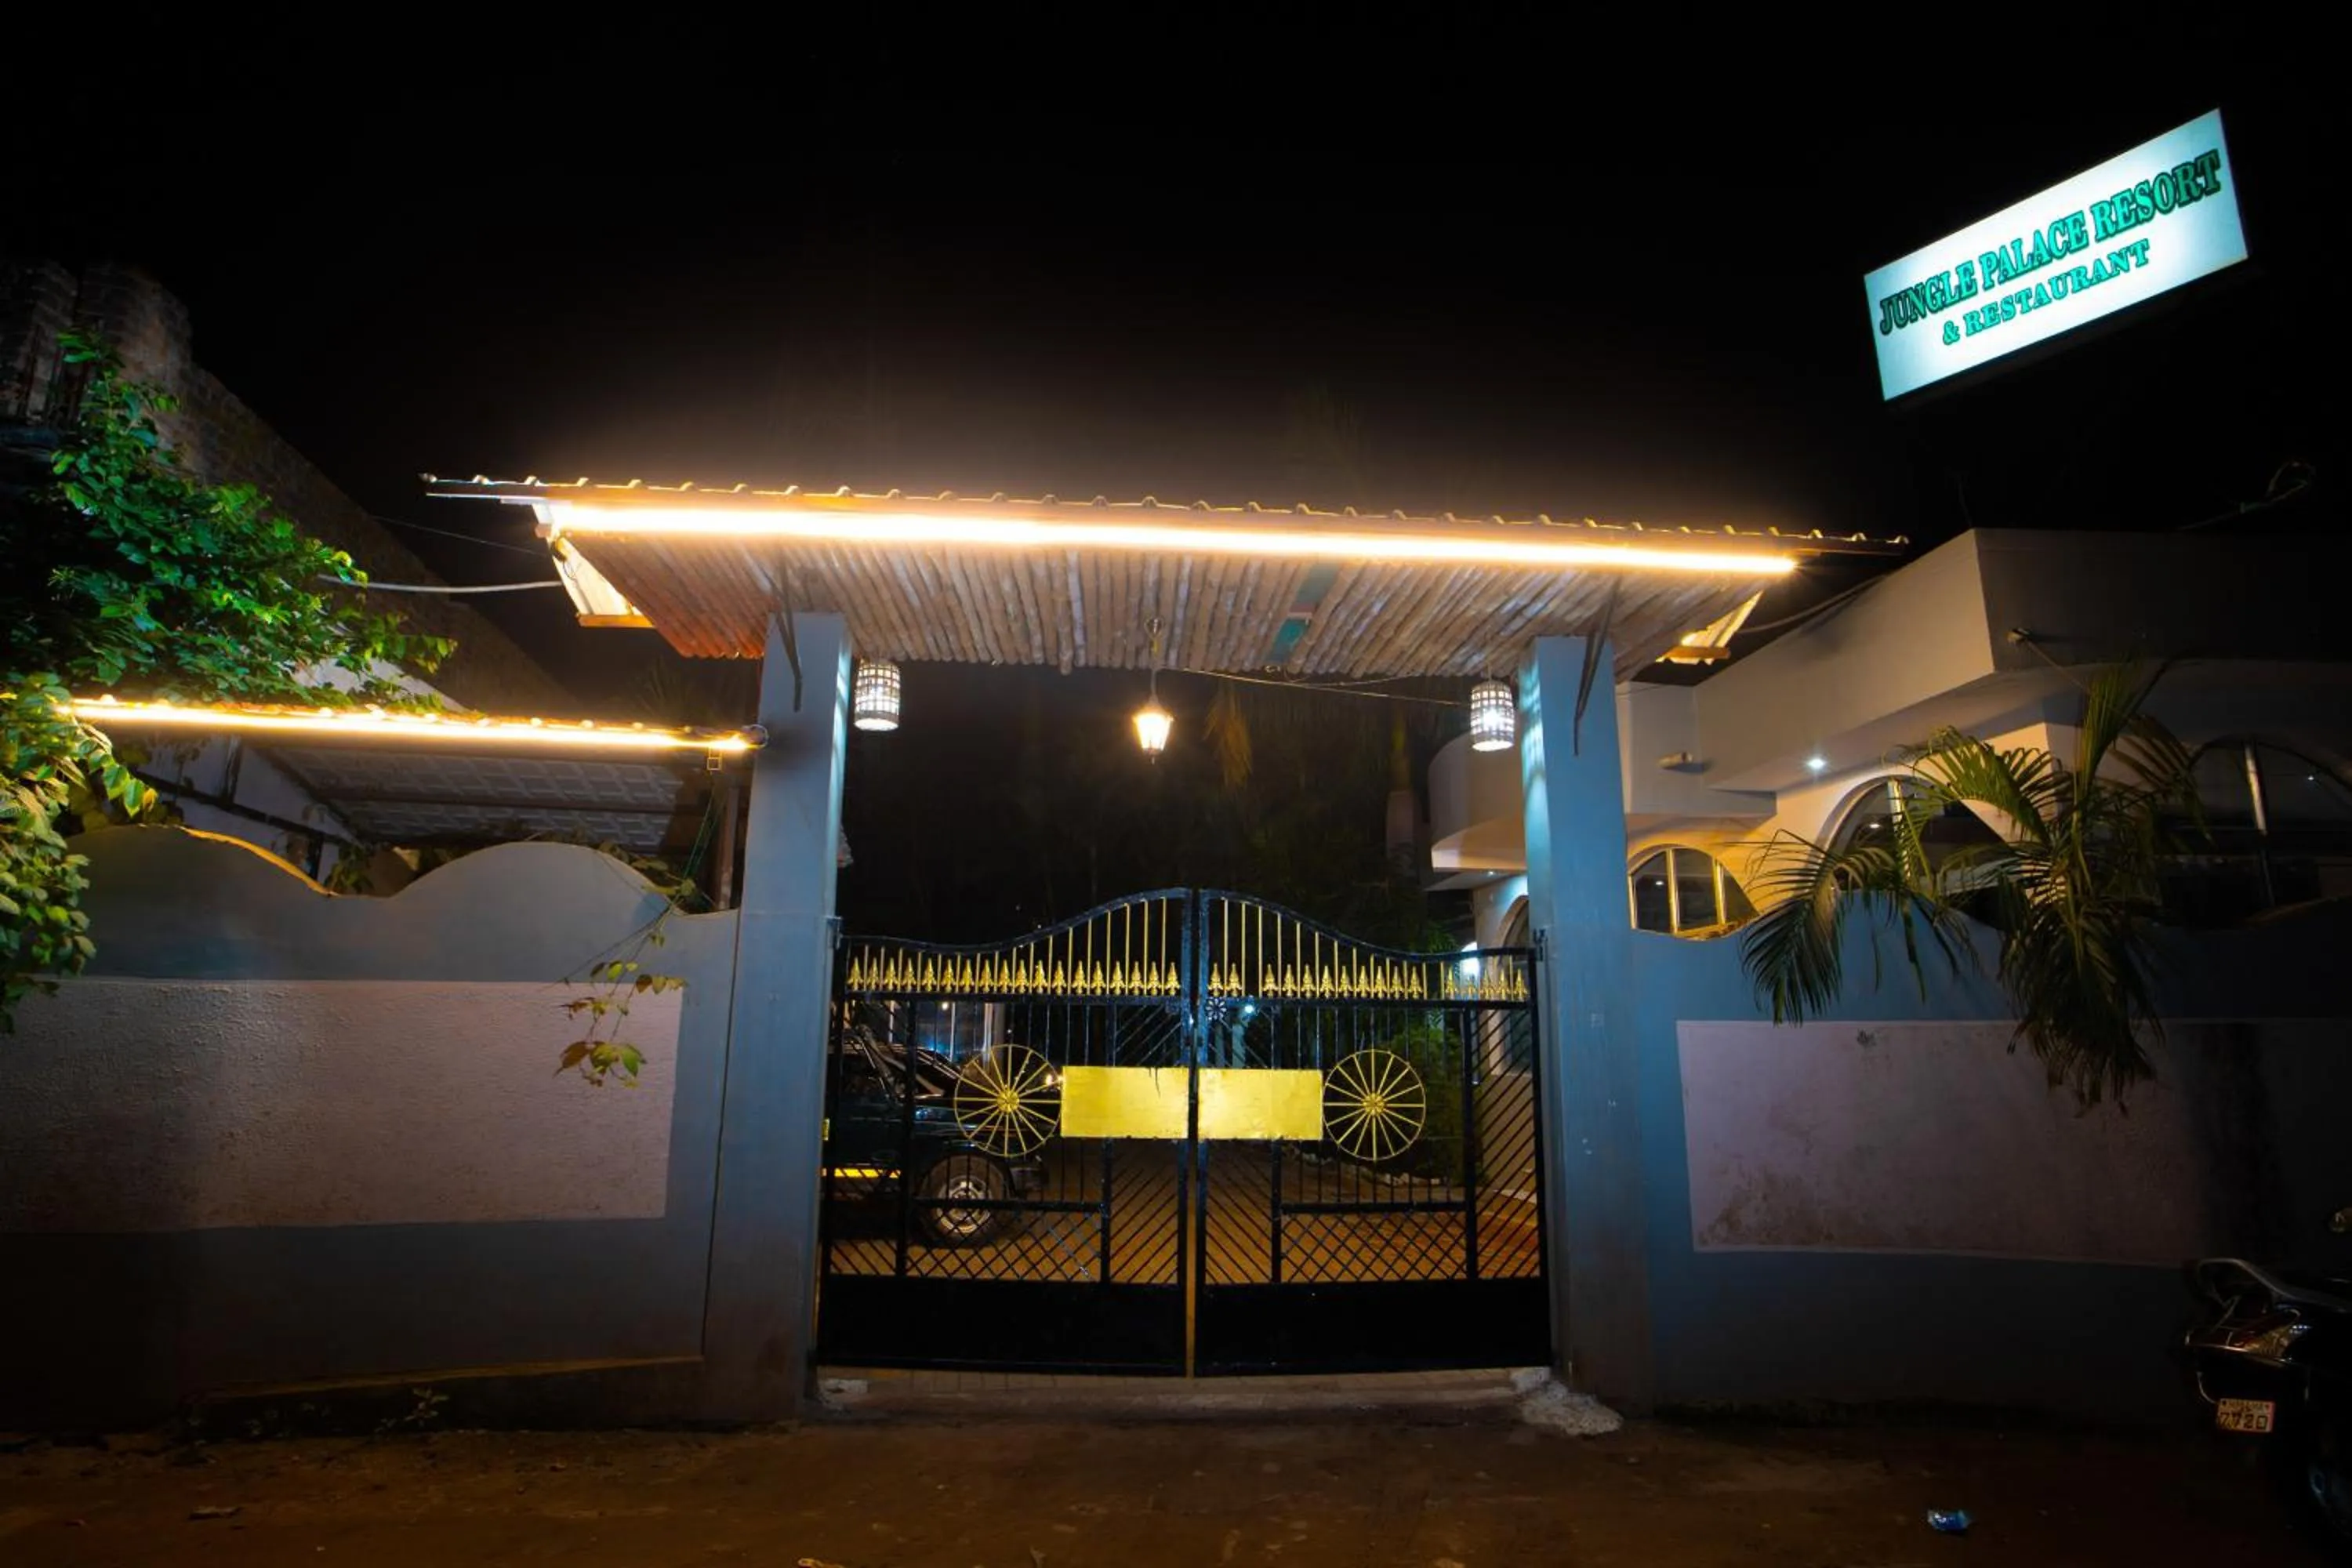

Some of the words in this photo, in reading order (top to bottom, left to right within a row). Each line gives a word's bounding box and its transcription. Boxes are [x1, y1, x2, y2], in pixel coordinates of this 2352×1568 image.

[1879, 260, 1978, 336] JUNGLE
[1979, 209, 2089, 291] PALACE
[2091, 149, 2221, 243] RESORT
[1943, 320, 1961, 346] &
[1965, 238, 2151, 338] RESTAURANT
